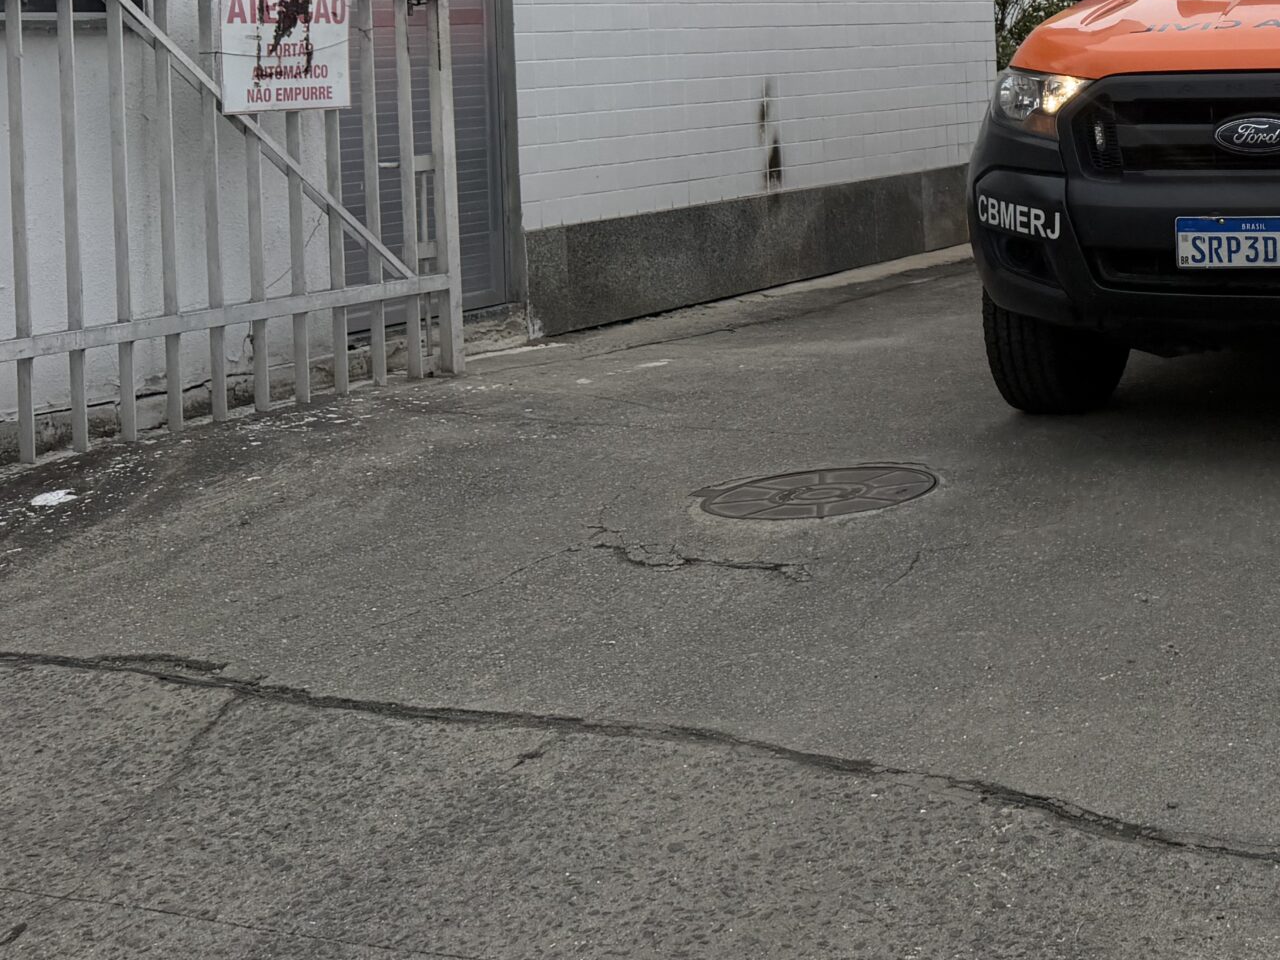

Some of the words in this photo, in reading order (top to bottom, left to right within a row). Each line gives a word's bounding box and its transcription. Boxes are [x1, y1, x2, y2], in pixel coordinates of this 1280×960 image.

[252, 62, 328, 80] AUTOMÁICO
[276, 86, 333, 102] EMPURRE
[1233, 123, 1280, 144] Ford
[978, 194, 1061, 240] CBMERJ
[1180, 255, 1190, 265] BR
